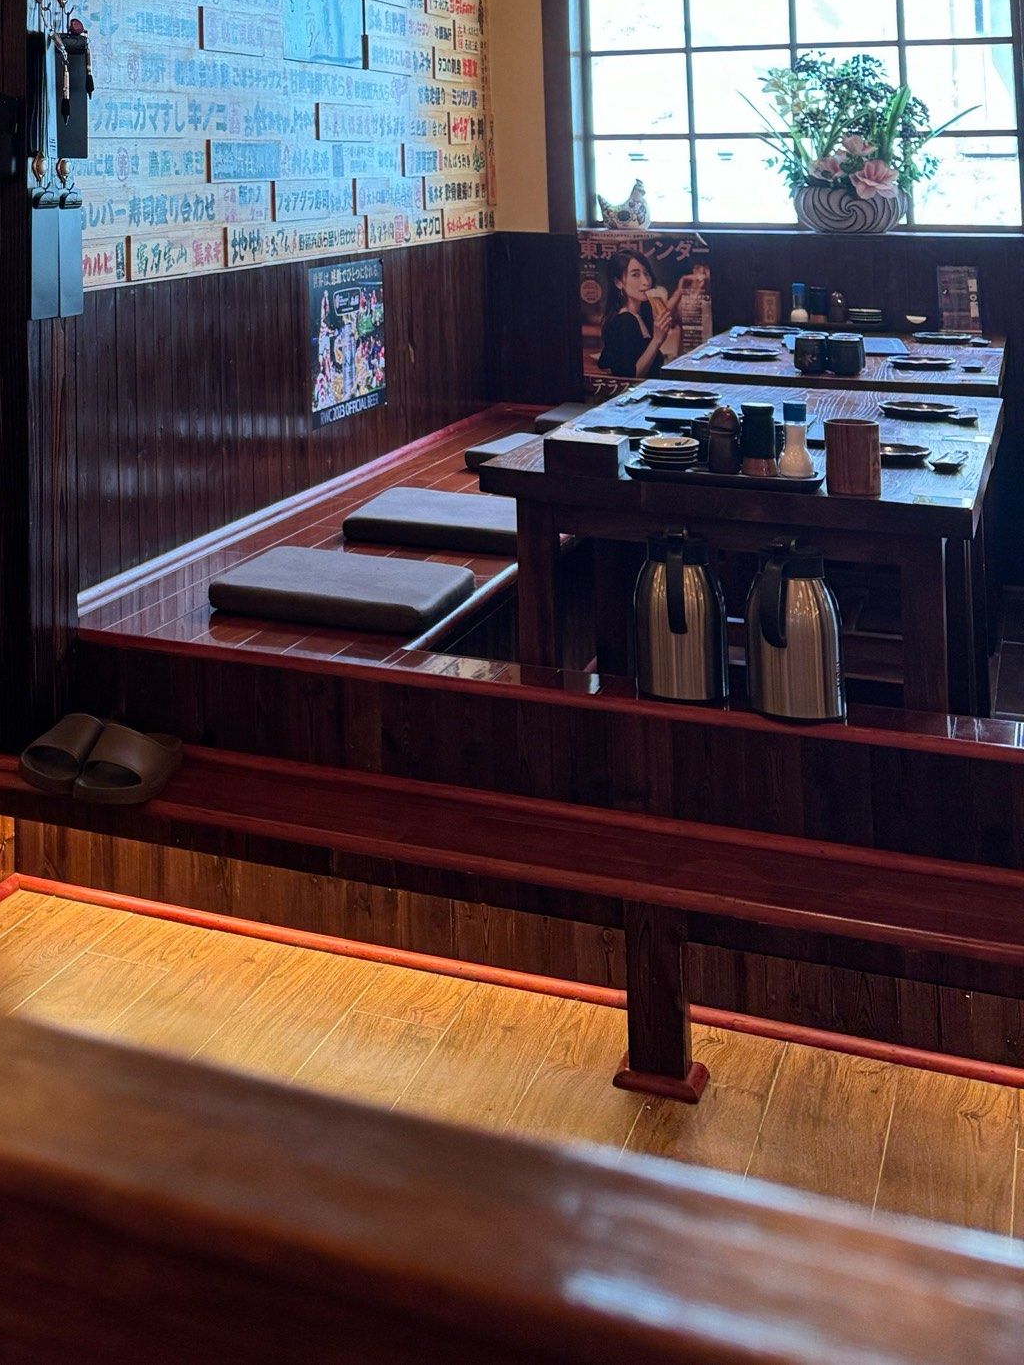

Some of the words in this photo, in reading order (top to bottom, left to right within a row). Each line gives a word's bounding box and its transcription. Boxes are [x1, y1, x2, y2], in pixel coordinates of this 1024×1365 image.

[129, 193, 216, 227] 寿司盛り合わせ
[332, 406, 345, 421] 2023
[345, 398, 367, 416] OFFICIAL
